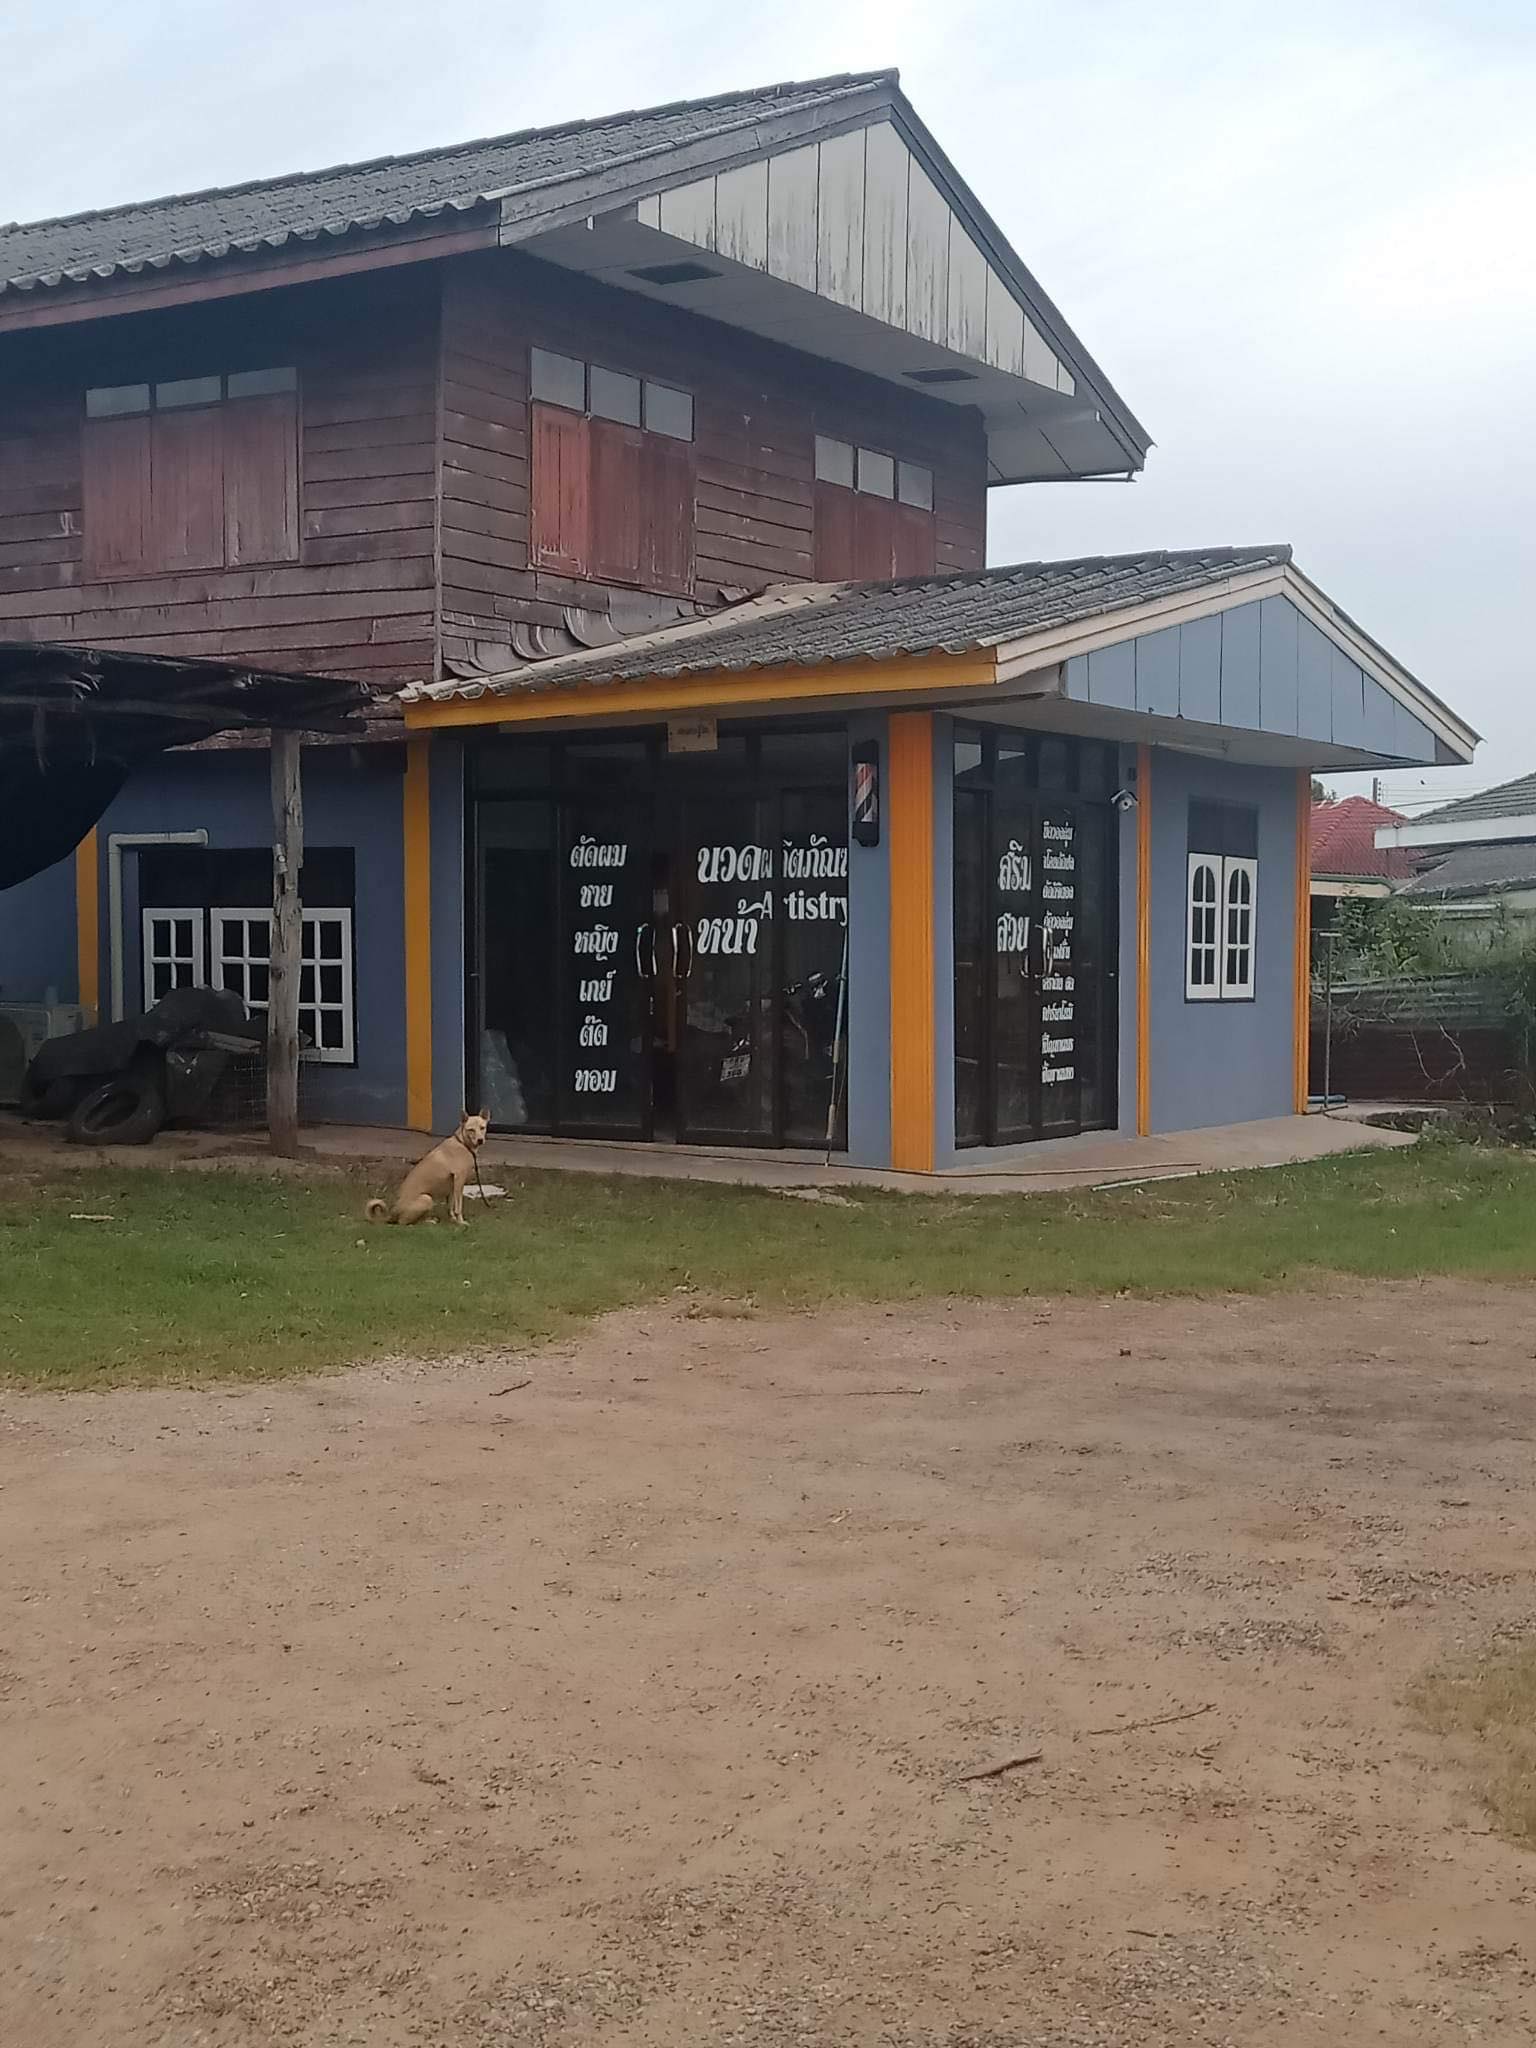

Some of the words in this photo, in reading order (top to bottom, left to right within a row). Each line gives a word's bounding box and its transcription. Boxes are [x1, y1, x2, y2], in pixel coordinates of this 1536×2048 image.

[570, 835, 627, 867] ตัดผม
[697, 845, 762, 882] นวด
[580, 884, 613, 907] ชาย
[760, 890, 848, 926] Atistry
[574, 924, 618, 961] หญิง
[697, 898, 764, 954] หน้า
[997, 912, 1030, 952] สวย
[580, 969, 616, 1002] เกย์
[575, 1069, 616, 1092] ทอม
